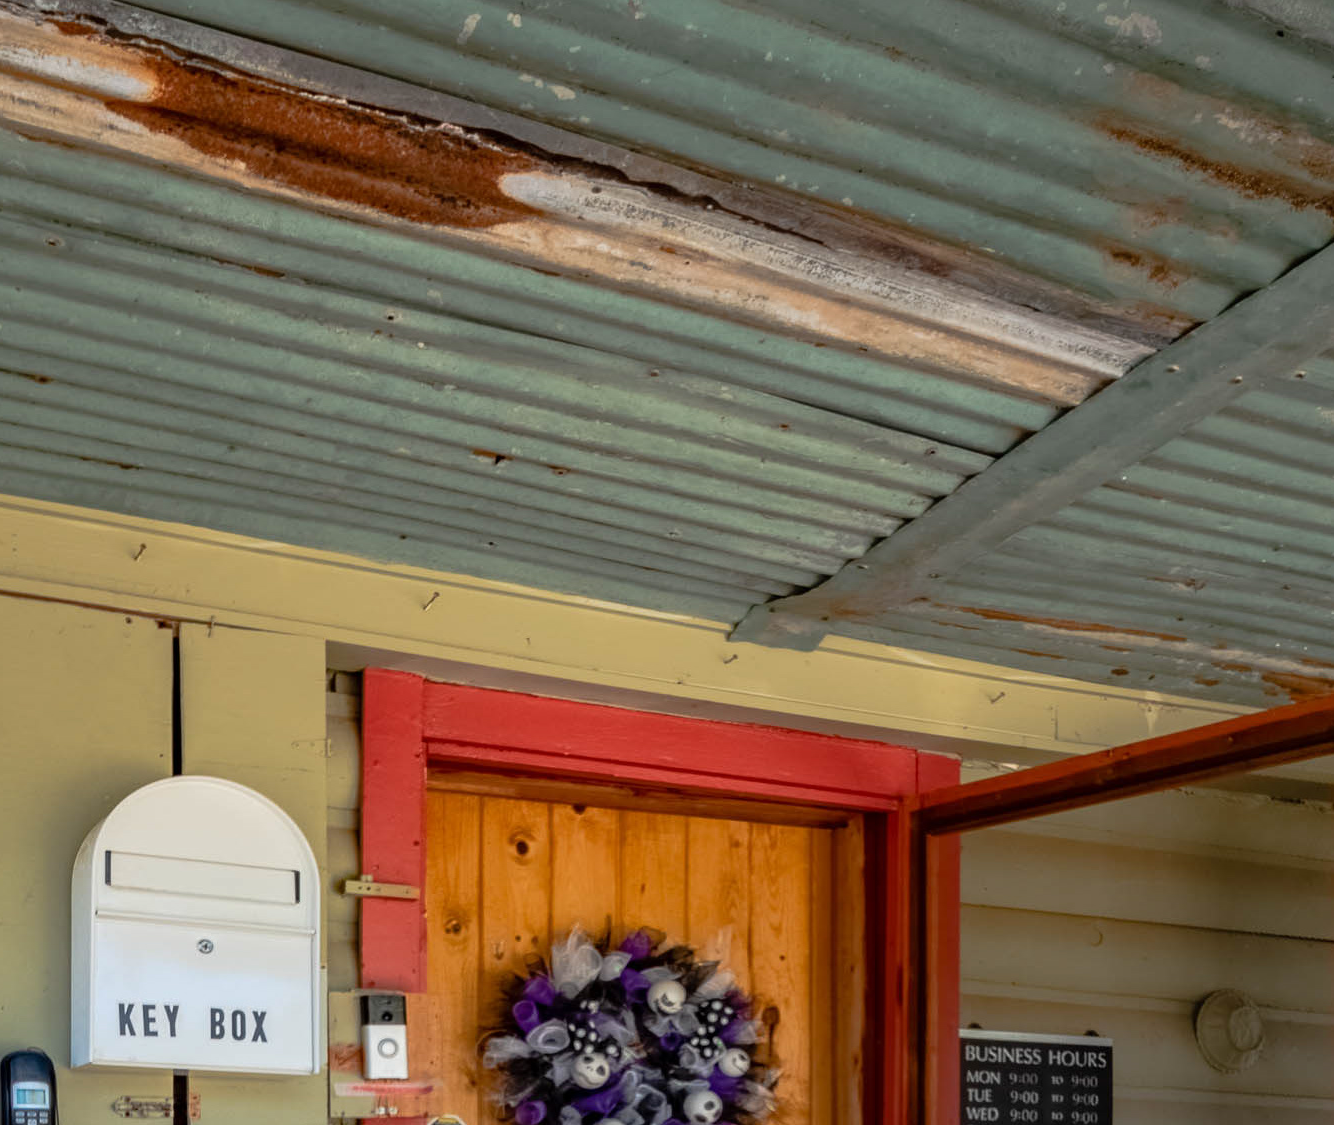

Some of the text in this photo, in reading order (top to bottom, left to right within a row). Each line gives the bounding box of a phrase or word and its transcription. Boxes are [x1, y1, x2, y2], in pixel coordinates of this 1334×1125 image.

[119, 1003, 268, 1043] KEY BOX
[965, 1046, 1107, 1068] BUSINESS HOURS
[966, 1070, 1001, 1084] MON
[1008, 1072, 1038, 1085] 9:00
[1071, 1076, 1098, 1088] 9:00
[967, 1089, 993, 1103] TUE
[1010, 1091, 1039, 1104] 9:00
[1072, 1094, 1099, 1107] 9:00
[966, 1107, 999, 1122] WED
[1010, 1109, 1038, 1122] 9:00
[1071, 1111, 1098, 1125] 9:00
